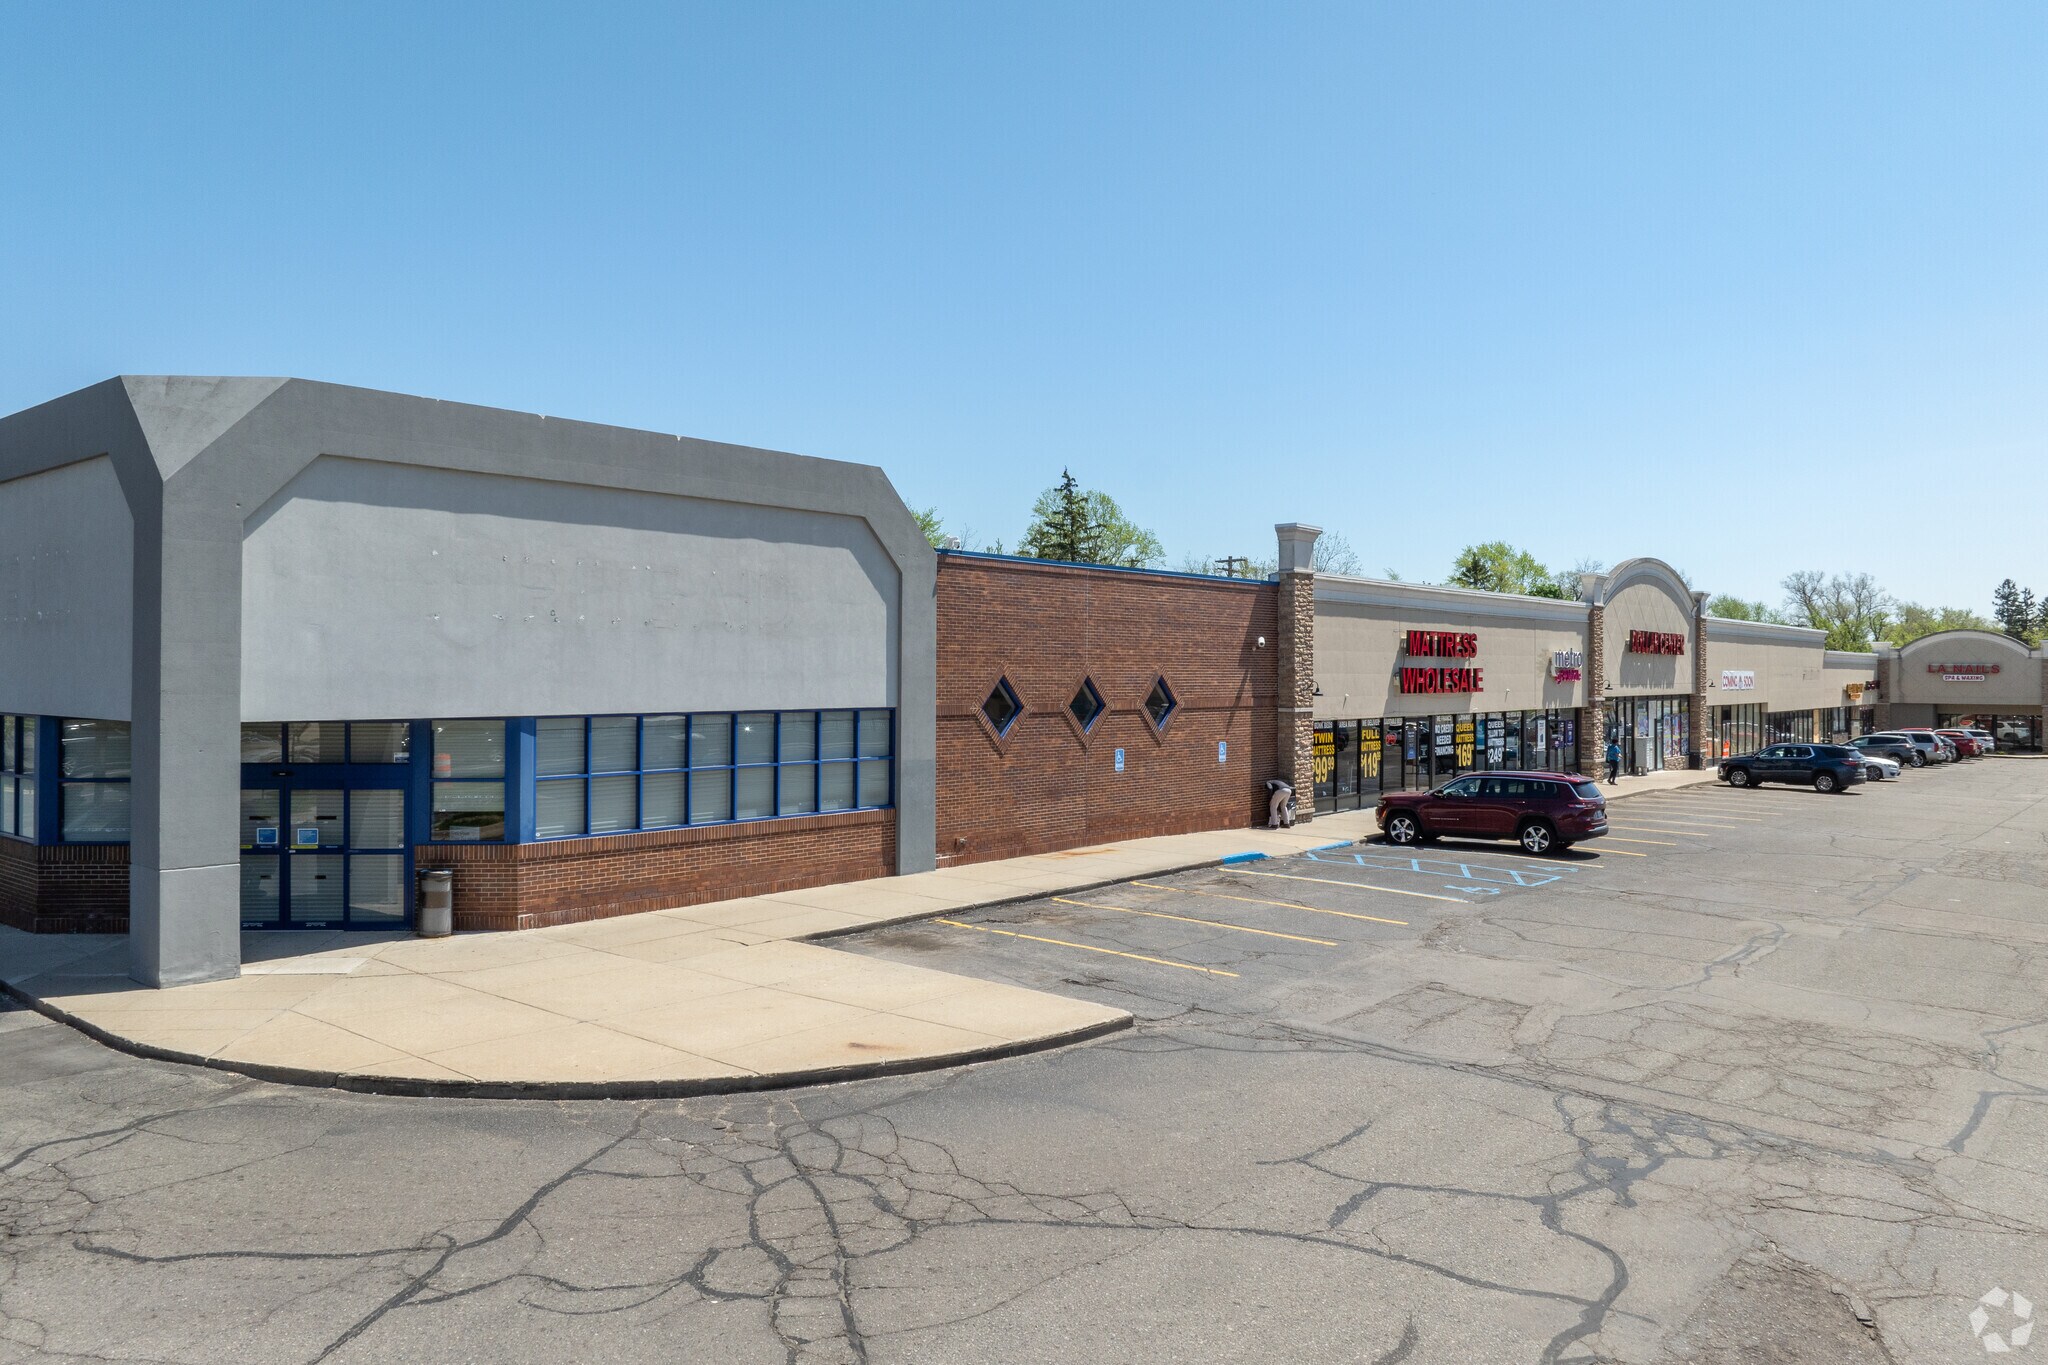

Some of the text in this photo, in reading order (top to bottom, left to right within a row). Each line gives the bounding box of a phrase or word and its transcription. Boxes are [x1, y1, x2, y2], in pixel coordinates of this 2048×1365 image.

[1408, 630, 1478, 658] MATTRESS
[1660, 633, 1684, 655] CENTER
[1554, 648, 1583, 669] metro
[1928, 664, 2000, 674] LA NAILS
[1400, 667, 1484, 694] WHOLESALE
[1722, 675, 1754, 688] COMING SOON
[1456, 723, 1474, 732] QUEEN
[1488, 721, 1505, 729] QUEEN
[1313, 732, 1334, 744] TWIN
[1361, 729, 1380, 740] FULL
